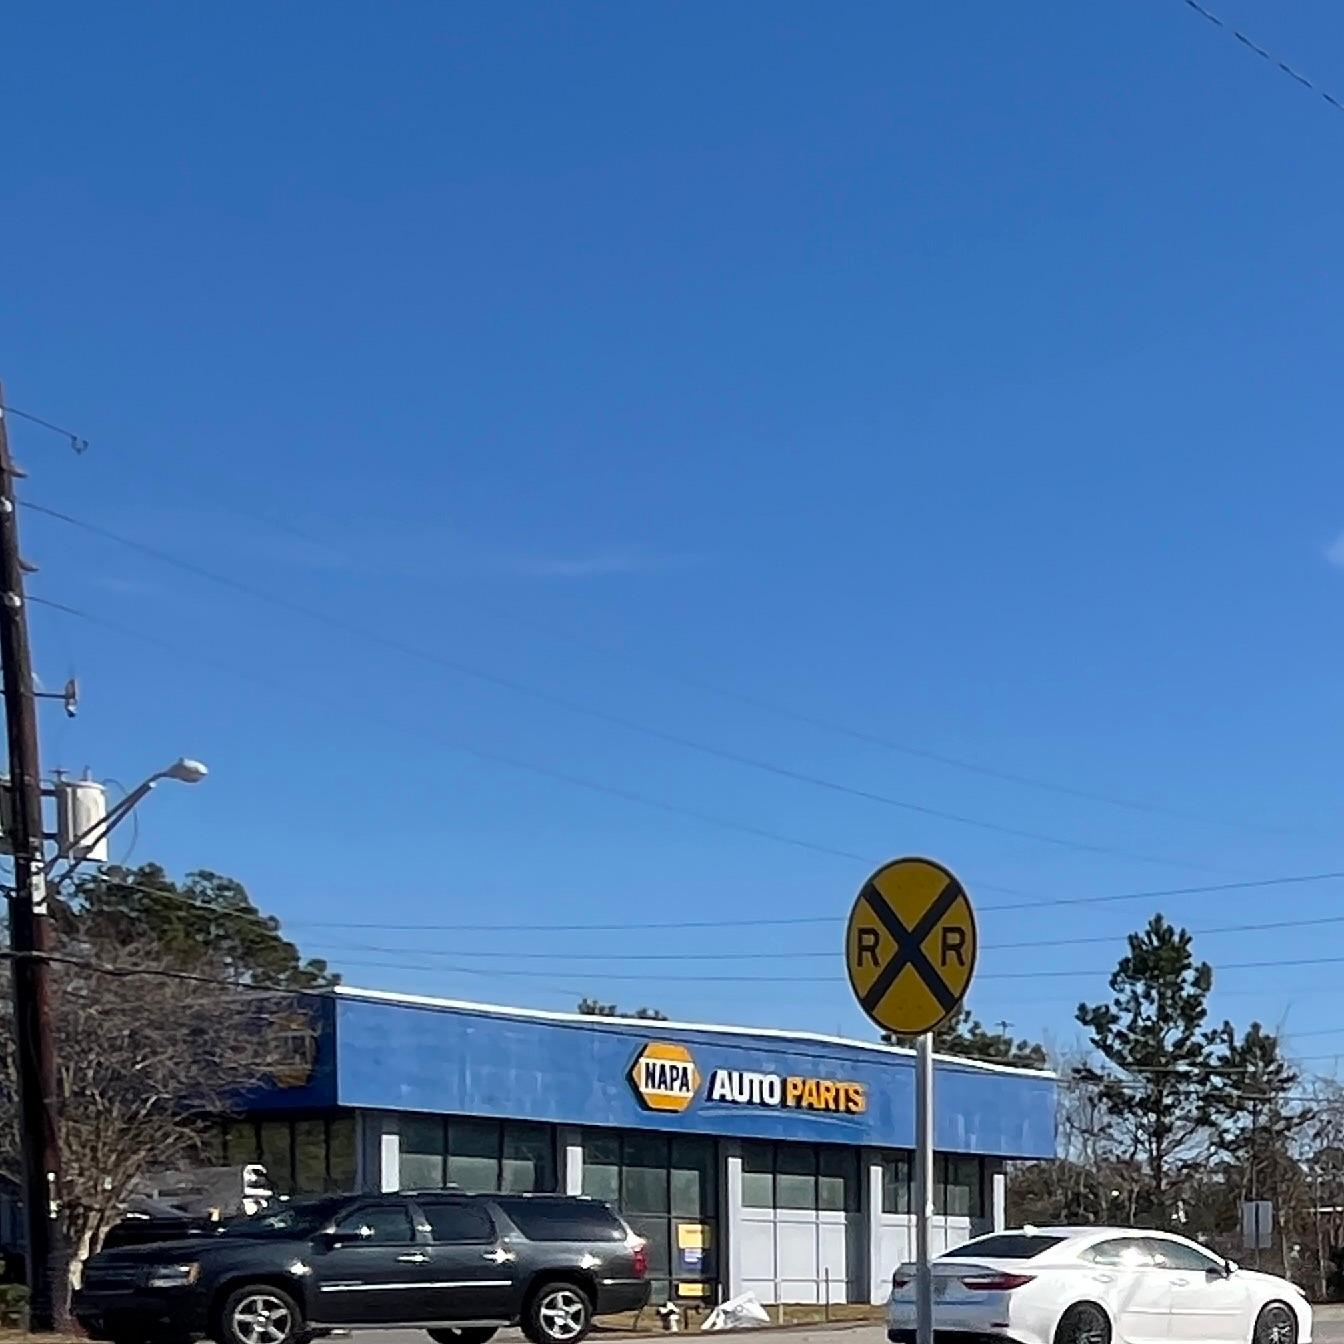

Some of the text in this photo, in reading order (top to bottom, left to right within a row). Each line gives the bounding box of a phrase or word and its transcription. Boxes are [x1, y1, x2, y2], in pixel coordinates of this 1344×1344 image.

[857, 926, 966, 968] R R
[644, 1063, 866, 1114] NAPA AUTO PARTS
